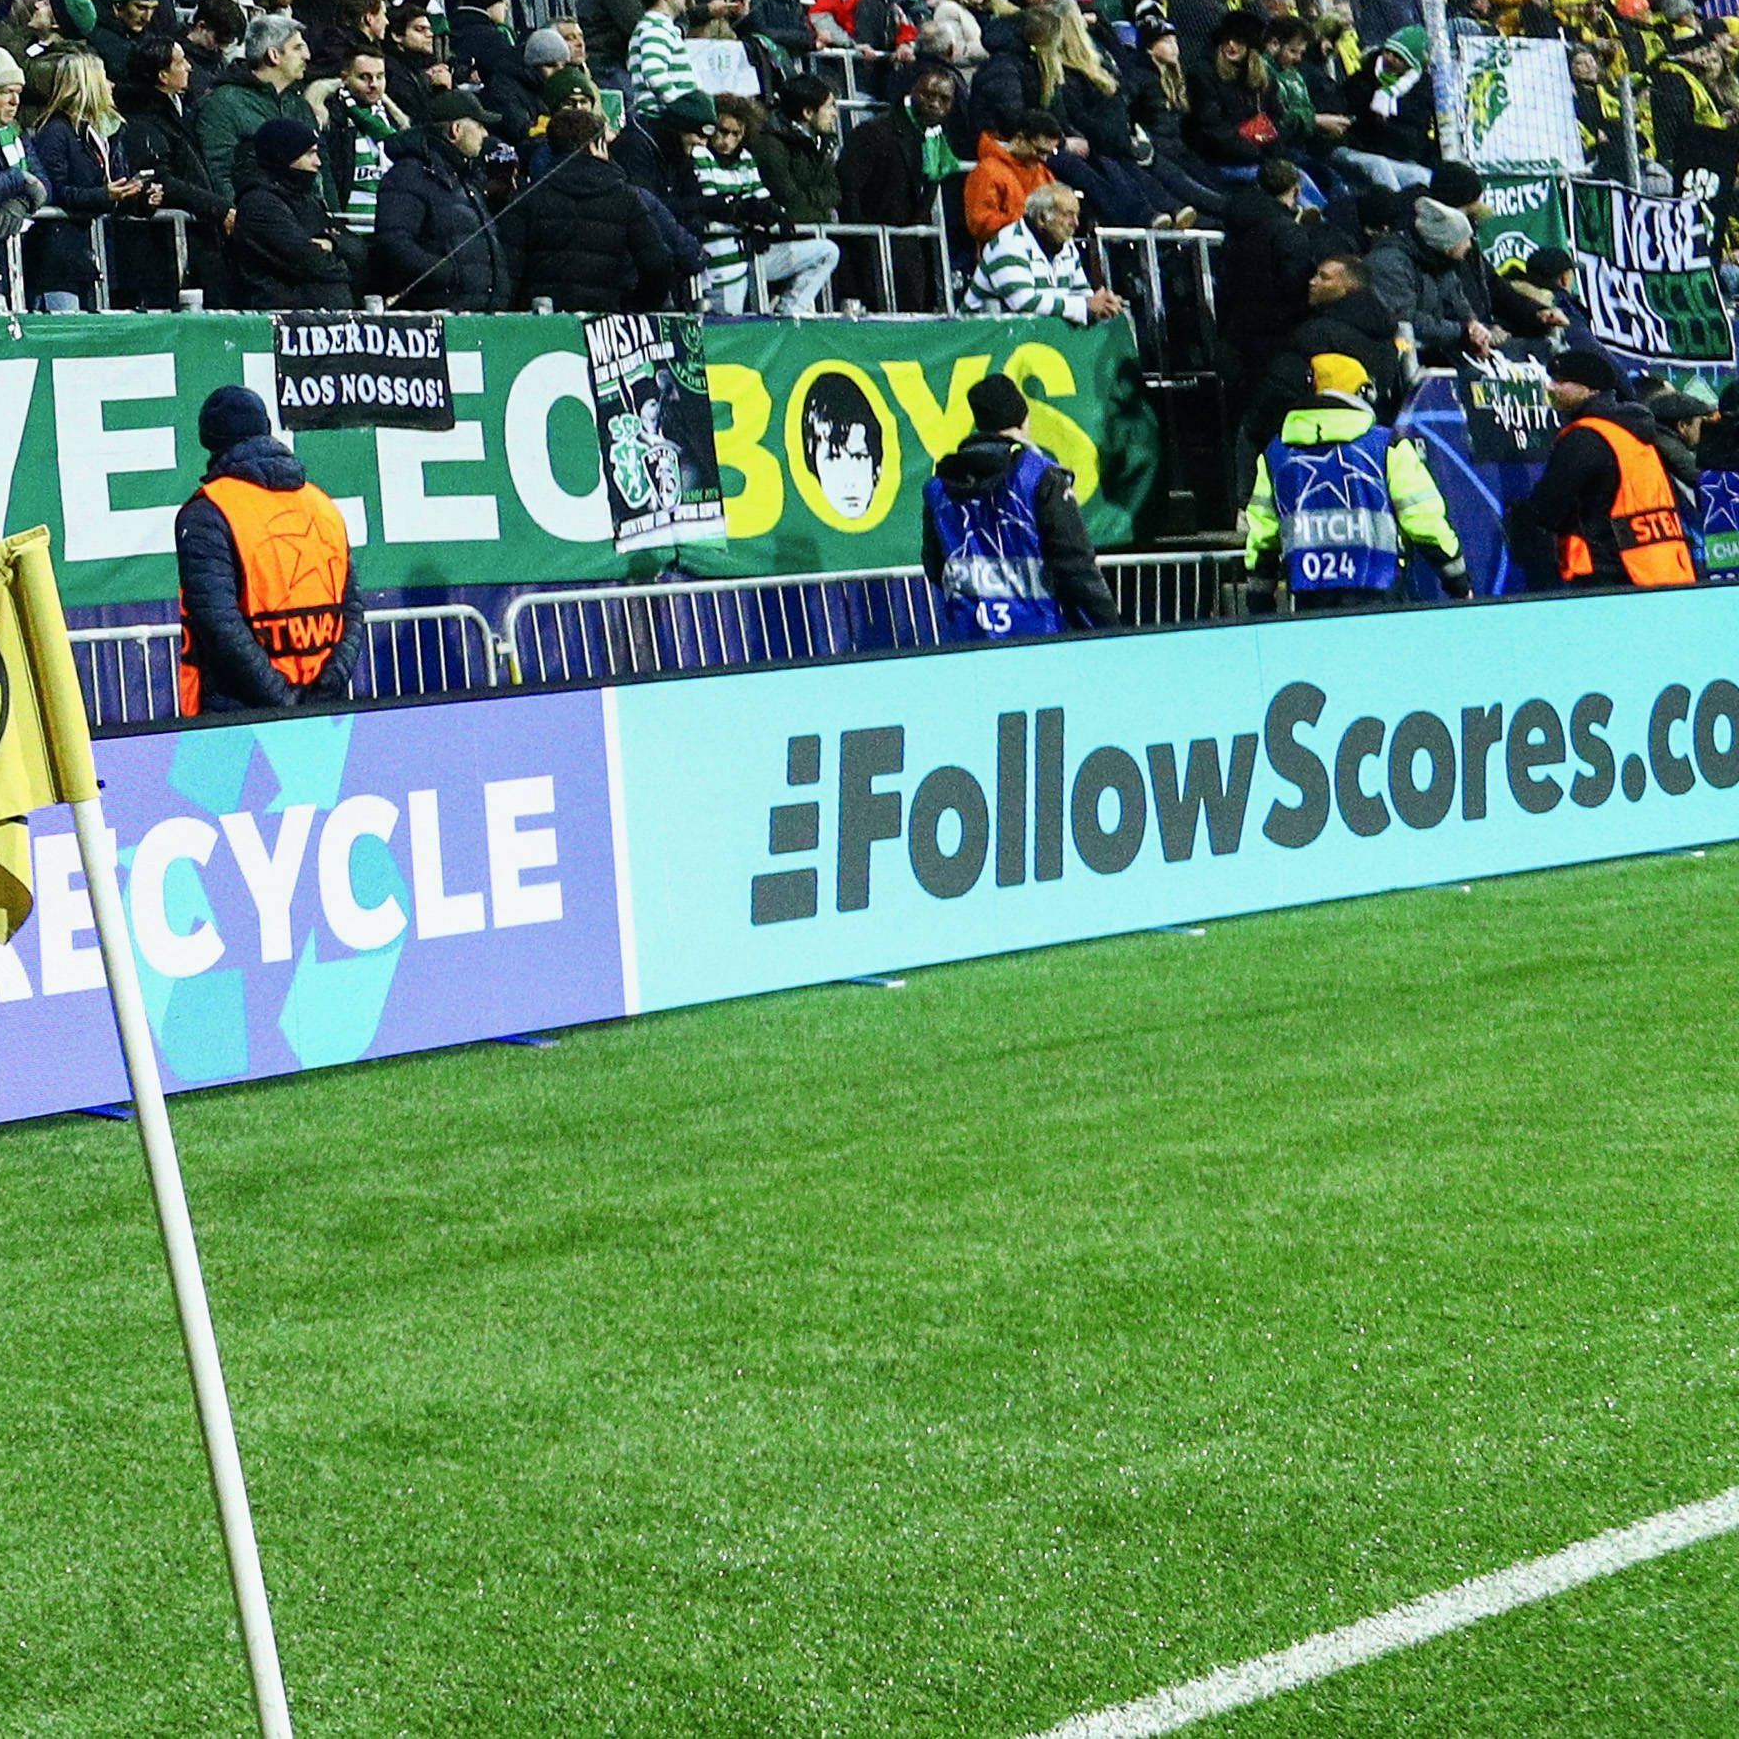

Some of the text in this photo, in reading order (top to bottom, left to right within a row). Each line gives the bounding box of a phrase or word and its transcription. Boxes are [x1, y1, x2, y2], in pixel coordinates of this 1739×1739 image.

[280, 323, 441, 359] LIBERDADE
[281, 372, 445, 409] AOS NOSSOS!
[1301, 551, 1357, 581] 024
[836, 680, 1739, 913] FollowScores.co
